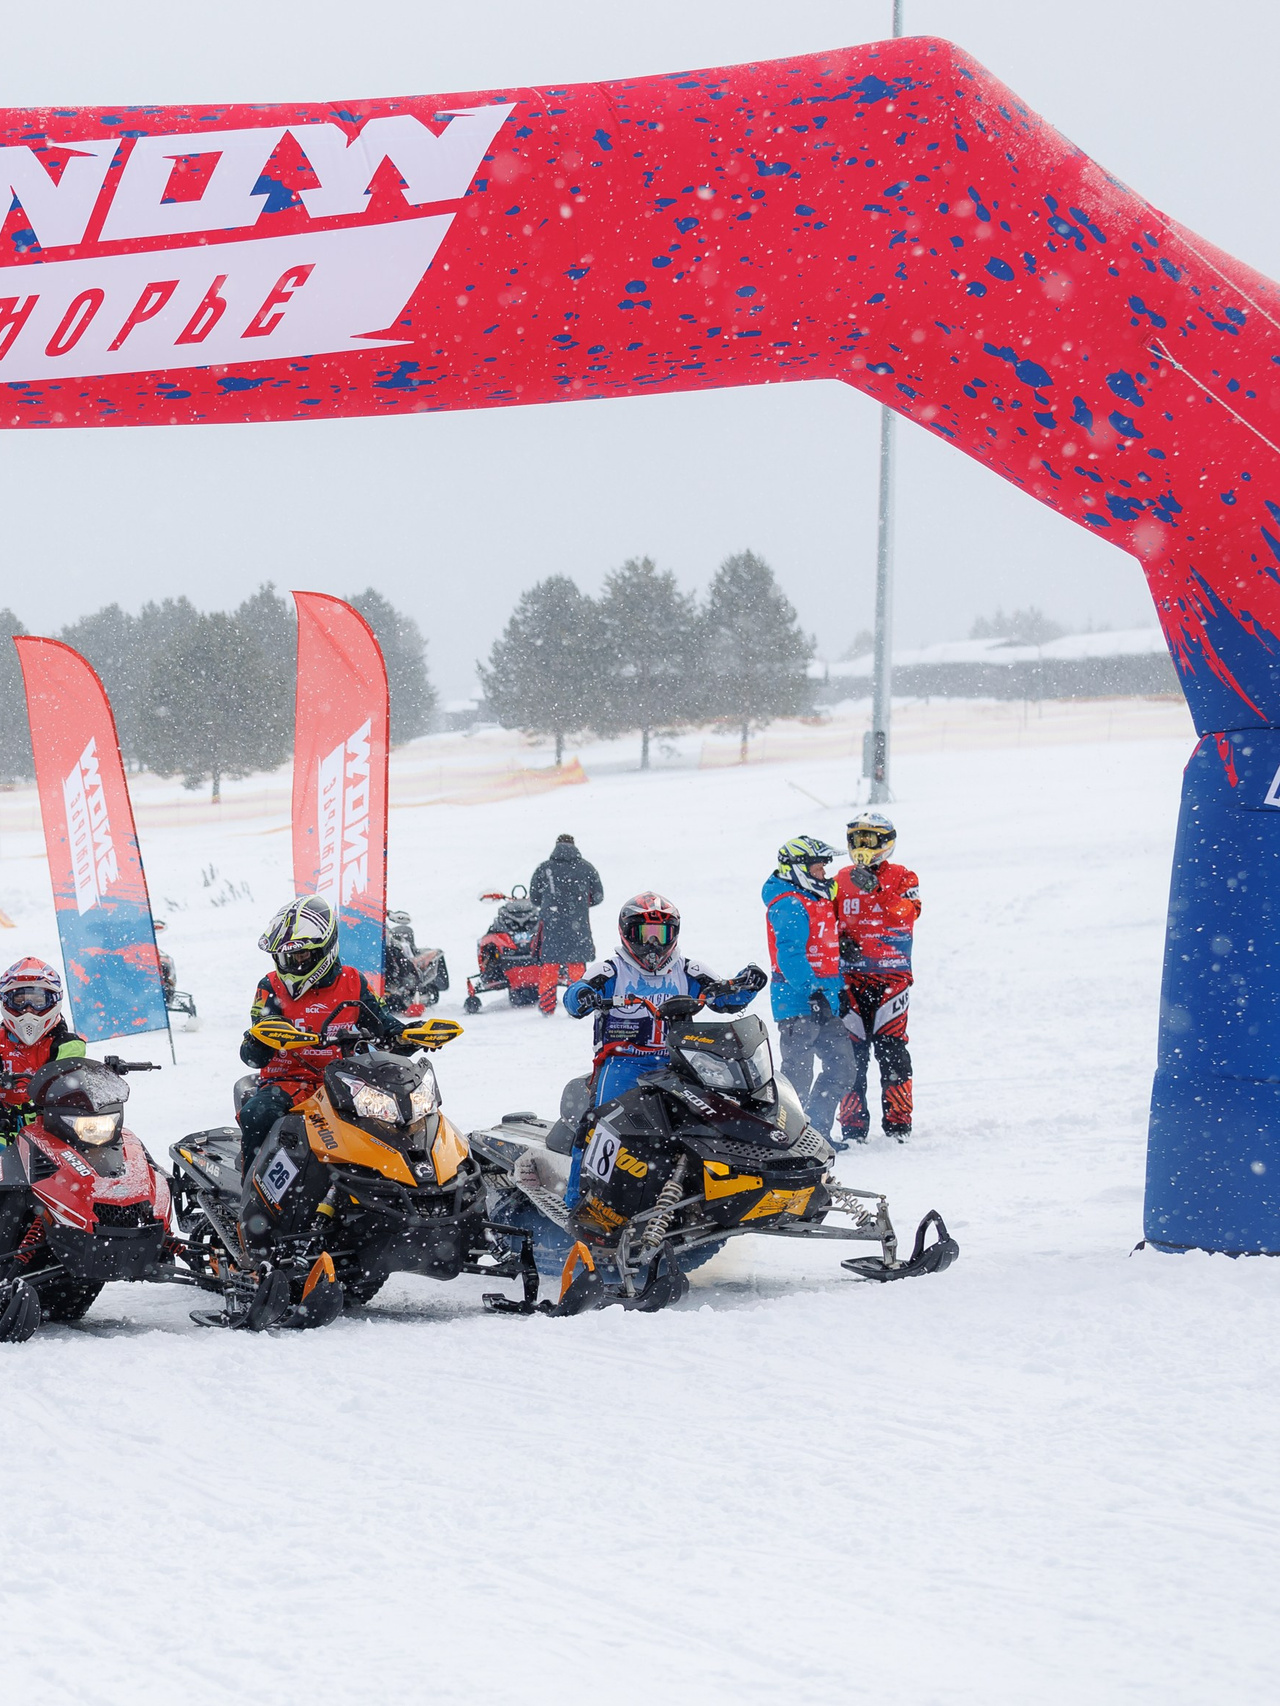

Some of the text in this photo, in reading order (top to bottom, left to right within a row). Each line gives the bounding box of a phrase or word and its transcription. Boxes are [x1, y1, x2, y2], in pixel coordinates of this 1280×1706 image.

[843, 898, 860, 915] 89
[680, 1089, 718, 1115] SCOTT
[308, 1113, 339, 1151] ski-doo
[586, 1132, 615, 1177] 18
[267, 1161, 290, 1190] 26
